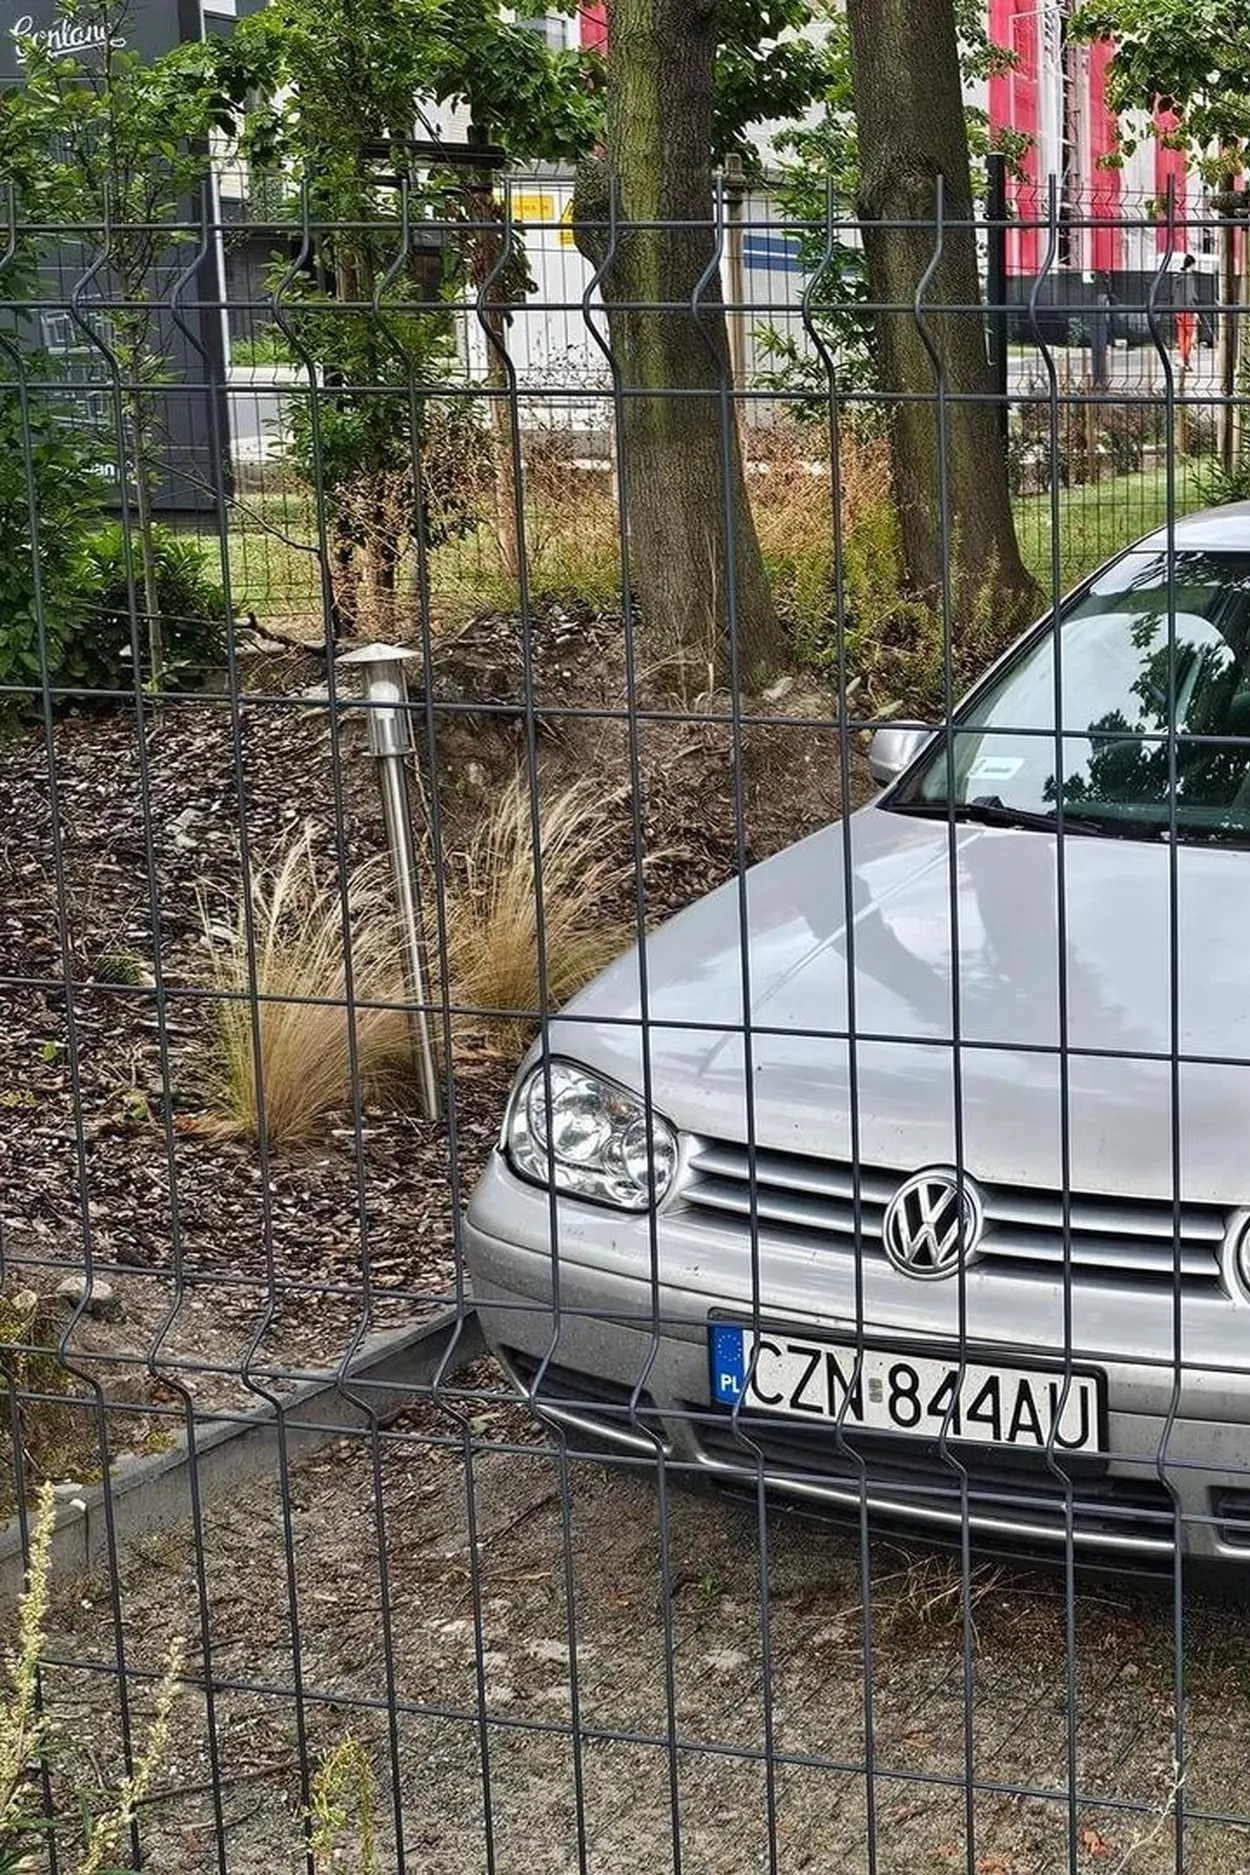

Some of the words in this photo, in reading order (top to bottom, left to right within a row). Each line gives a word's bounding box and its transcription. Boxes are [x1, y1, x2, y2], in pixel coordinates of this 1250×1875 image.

[720, 1373, 741, 1394] PL
[749, 1340, 865, 1421] CZN
[887, 1363, 1090, 1449] 844AU
